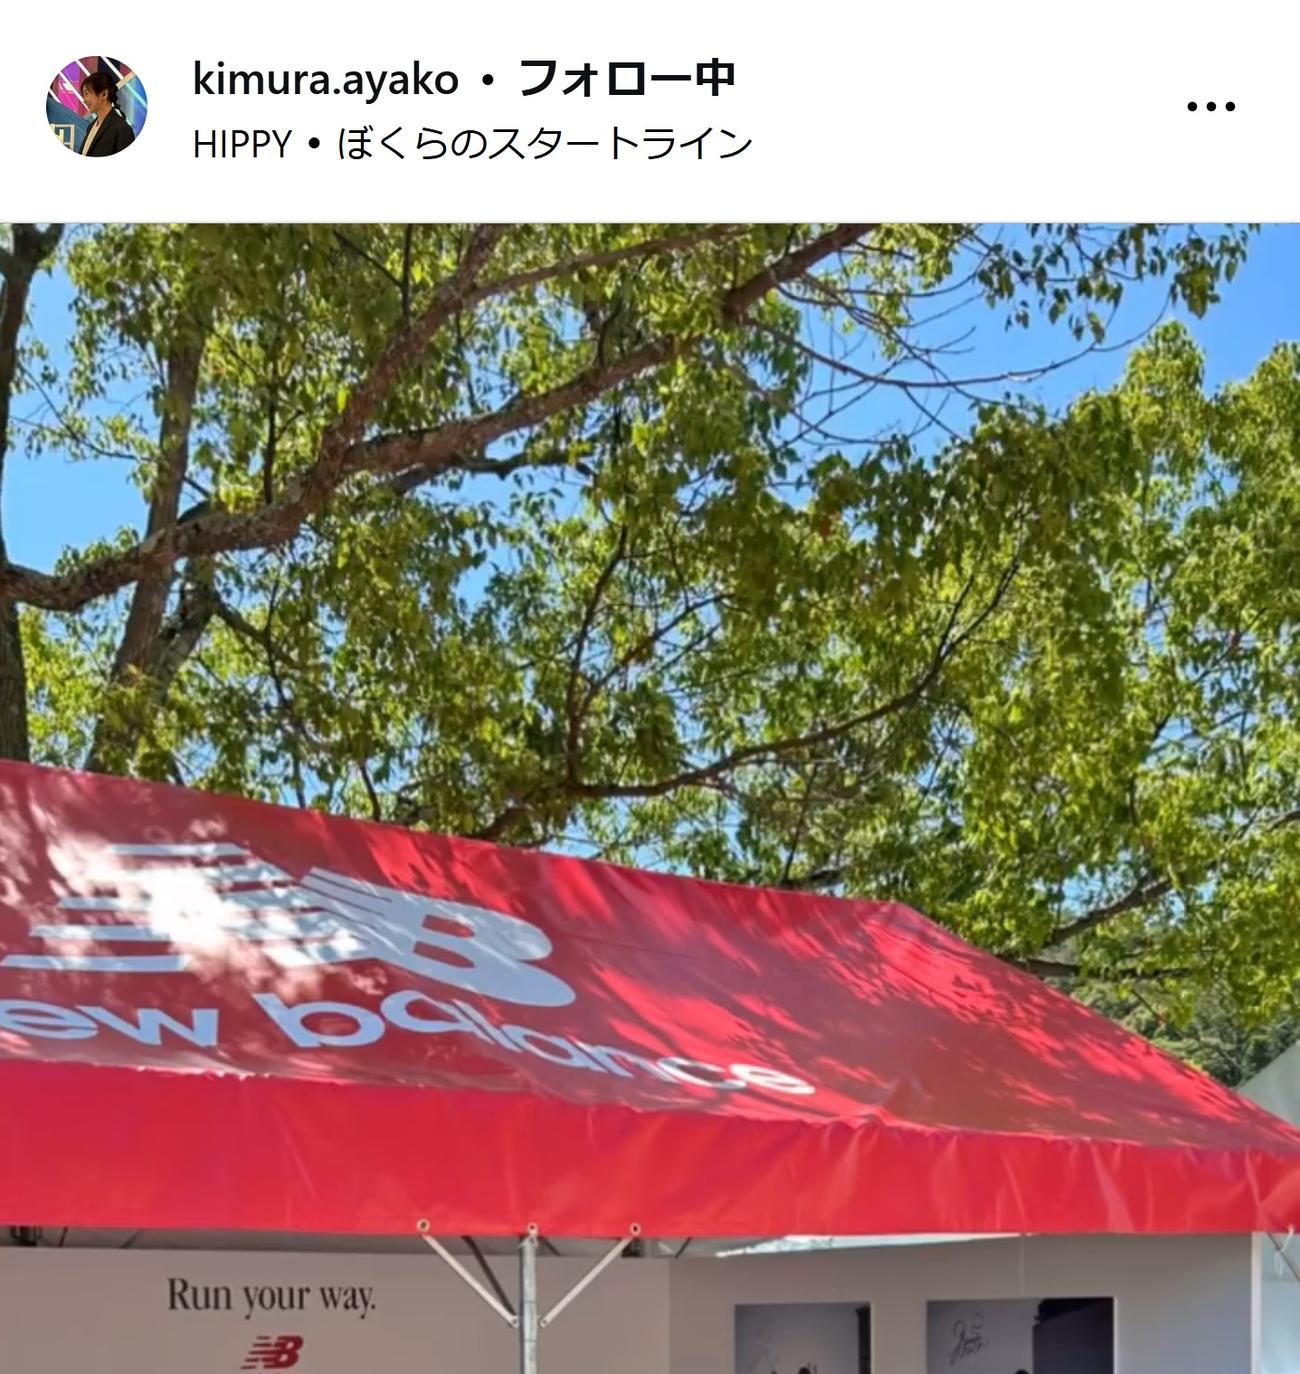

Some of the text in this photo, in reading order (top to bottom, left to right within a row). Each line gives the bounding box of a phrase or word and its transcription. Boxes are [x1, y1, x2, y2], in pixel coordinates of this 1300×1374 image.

[0, 989, 816, 1096] ew balance
[167, 1276, 376, 1321] Run your way.
